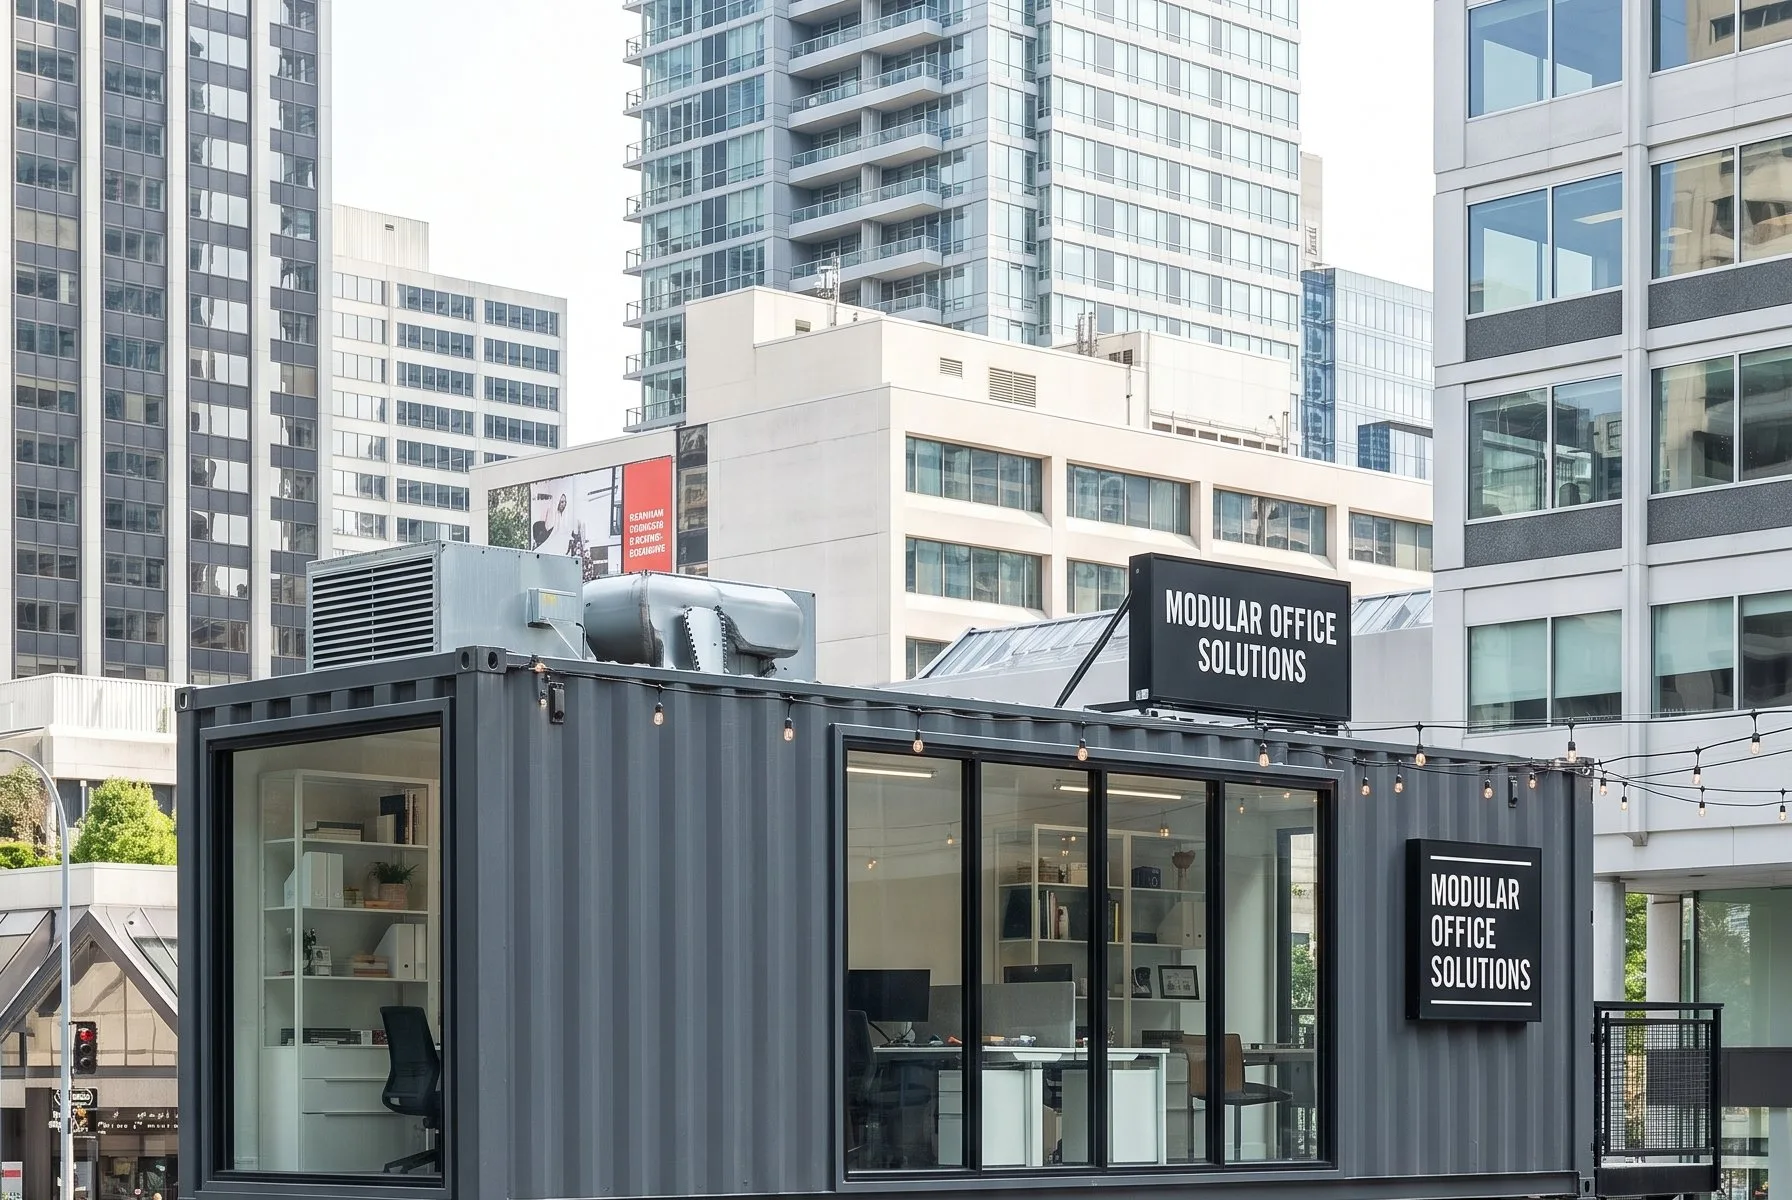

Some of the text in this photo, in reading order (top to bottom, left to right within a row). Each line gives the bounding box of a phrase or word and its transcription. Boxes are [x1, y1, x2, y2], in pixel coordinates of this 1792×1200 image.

[1165, 589, 1337, 645] MODULAR OFFICE
[1198, 637, 1306, 683] SOLUTIONS
[1431, 873, 1520, 910] MODULAR
[1431, 914, 1496, 949] OFFICE
[1430, 955, 1531, 991] SOLUTIONS
